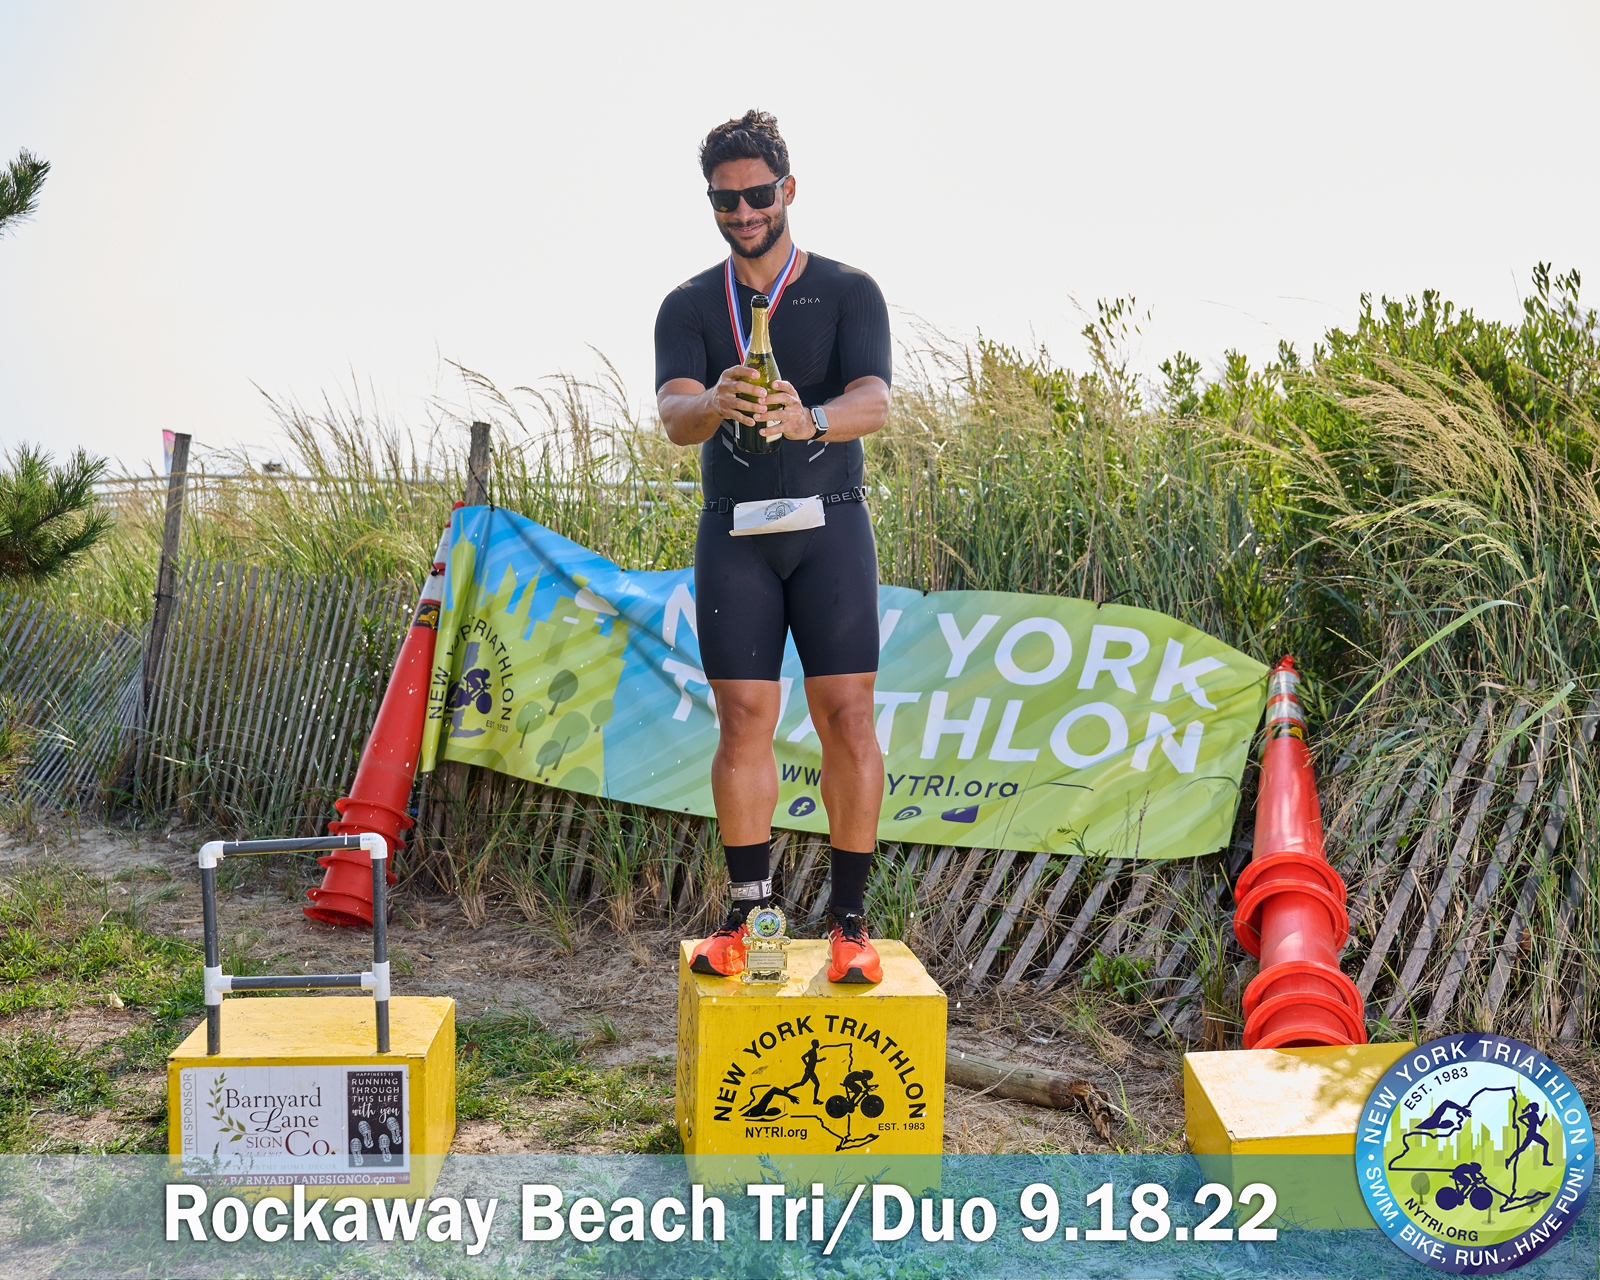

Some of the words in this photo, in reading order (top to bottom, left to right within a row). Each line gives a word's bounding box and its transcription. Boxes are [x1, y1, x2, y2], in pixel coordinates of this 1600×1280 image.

[429, 666, 450, 719] NEW
[472, 616, 514, 721] RIATHLON
[936, 613, 1227, 711] YORK
[713, 1062, 746, 1121] NEW
[743, 1015, 814, 1059] YORK
[825, 1015, 926, 1118] TRIATHLON
[183, 1073, 193, 1130] SPONSOR
[225, 1086, 322, 1113] Barnyard
[352, 1102, 376, 1118] with
[379, 1107, 400, 1123] you
[249, 1107, 319, 1133] Lane
[745, 1126, 808, 1140] NYTRI.org
[878, 1123, 899, 1131] EST.
[903, 1122, 925, 1130] 1983
[184, 1134, 193, 1160] YTRI
[246, 1136, 282, 1148] SIGN
[285, 1130, 336, 1157] Co.
